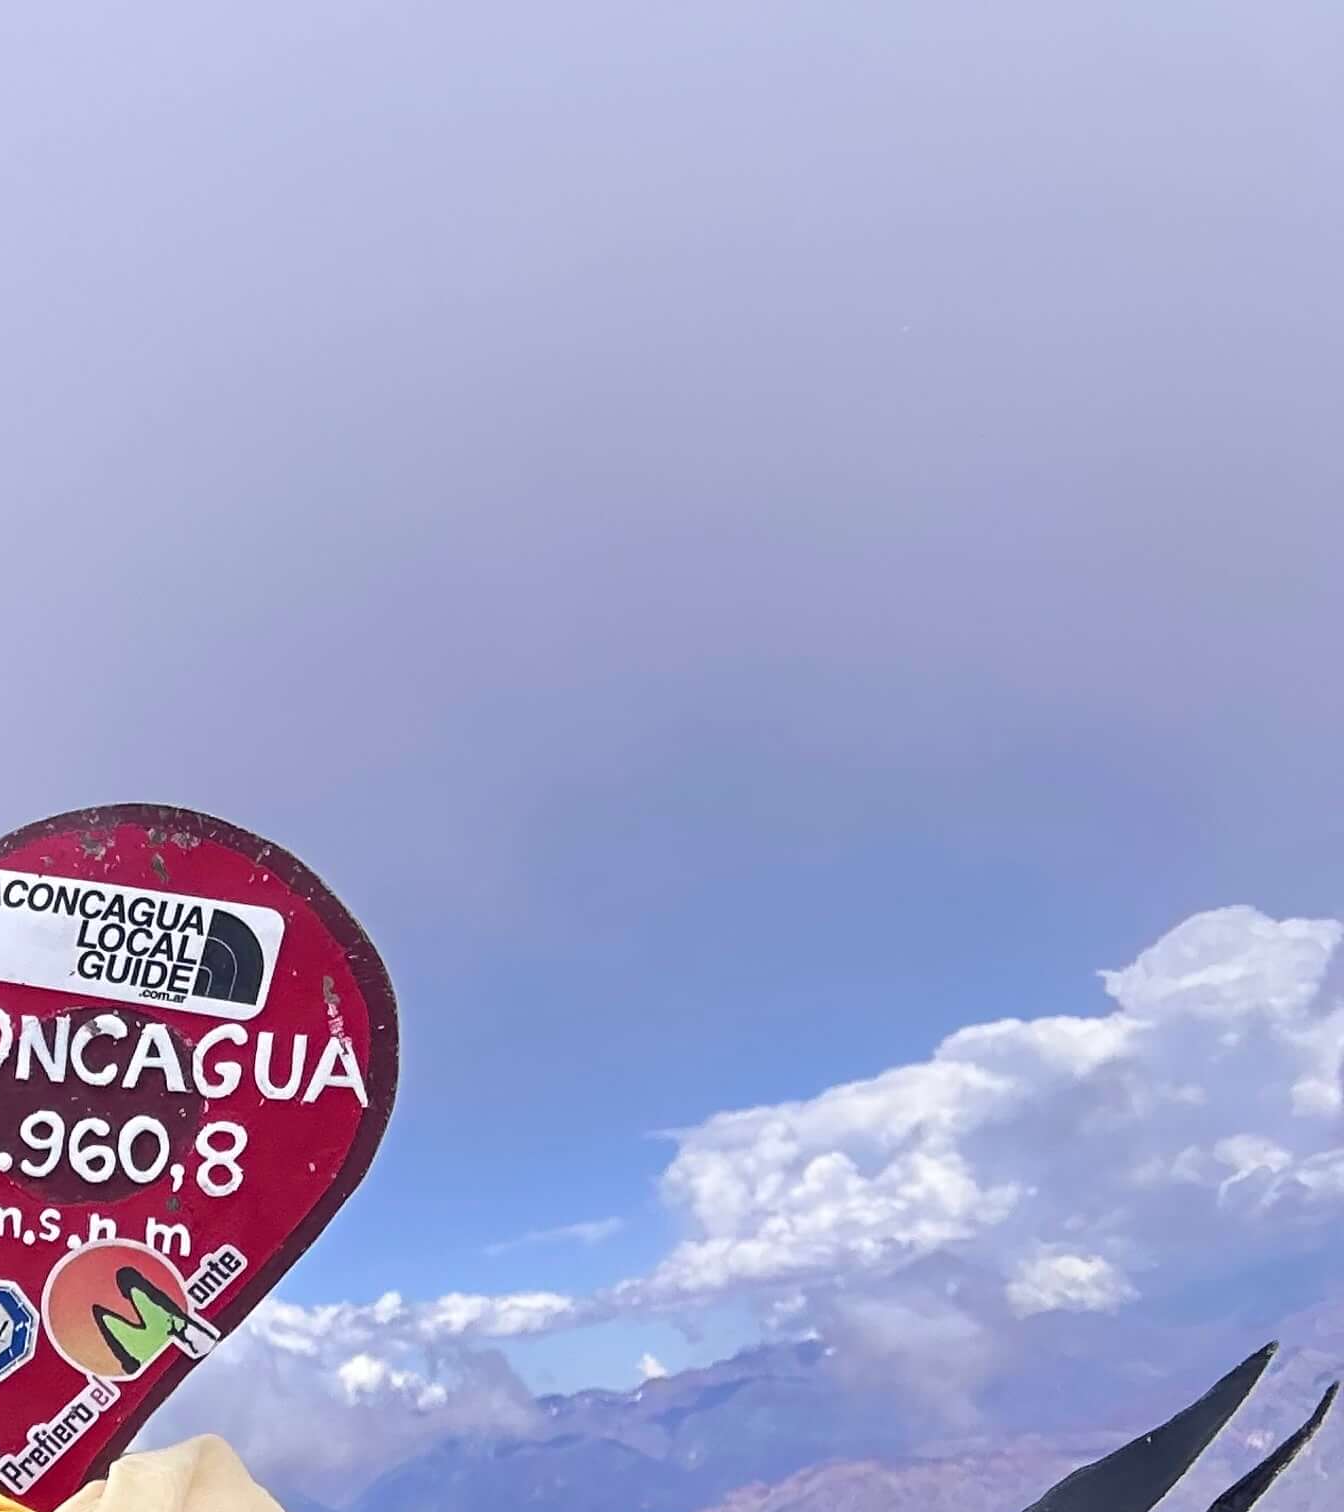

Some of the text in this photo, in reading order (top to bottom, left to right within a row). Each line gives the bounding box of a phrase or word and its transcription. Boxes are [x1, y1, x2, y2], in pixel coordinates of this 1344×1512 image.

[76, 919, 198, 965] LOCAL
[76, 950, 195, 994] GUIDE
[0, 1402, 95, 1490] Prefiero
[90, 1374, 115, 1406] el
